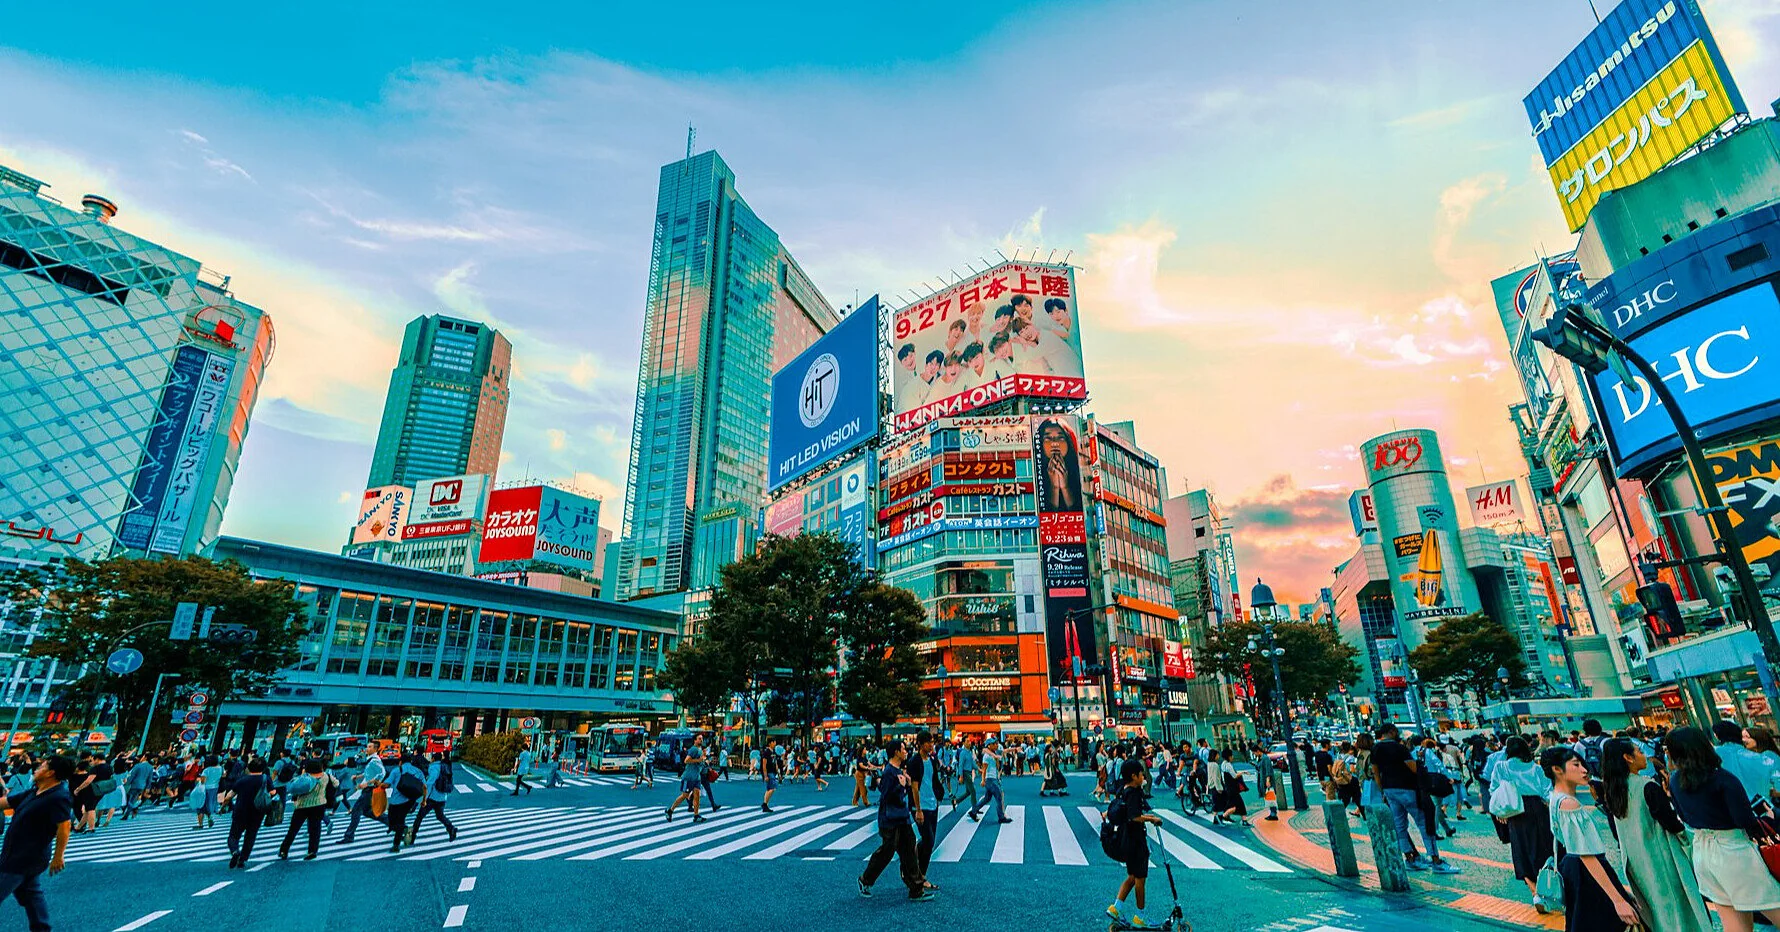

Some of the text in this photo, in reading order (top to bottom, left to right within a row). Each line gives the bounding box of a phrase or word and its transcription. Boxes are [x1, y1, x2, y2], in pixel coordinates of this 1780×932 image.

[1532, 0, 1677, 137] Hisamitsu
[1558, 76, 1708, 204] サロンパス
[896, 273, 1070, 340] 9.27 日本上陸
[1612, 279, 1678, 329] DHC
[1611, 325, 1759, 424] DHC
[1018, 377, 1083, 393] ワナワン
[952, 416, 1026, 426] しゃぶしゃぶバイキング
[780, 455, 797, 477] HIT
[798, 443, 820, 466] LED
[821, 417, 860, 452] VISION
[984, 430, 1028, 445] しゃぶ葉
[1373, 443, 1423, 470] 109
[881, 465, 889, 474] 9F
[945, 462, 1013, 476] コンタクト
[432, 482, 459, 503] DC
[890, 473, 931, 498] プライス
[993, 483, 1026, 495] ガスト
[913, 491, 934, 508] ガスト
[1476, 485, 1512, 511] H&M
[387, 491, 405, 536] SANKYO
[488, 508, 537, 527] カラオケ
[540, 498, 598, 529] 大声
[903, 510, 929, 532] ガスト
[975, 517, 1038, 527] 英会話イーオン
[1041, 513, 1084, 525] ユリゴコロ
[485, 525, 535, 539] JOYSOUND
[881, 525, 890, 537] 7F
[537, 540, 592, 560] JOYSOUND
[1044, 547, 1085, 562] Rihwa
[962, 677, 1010, 687] L'OCCITANE
[1168, 690, 1188, 705] LUSH
